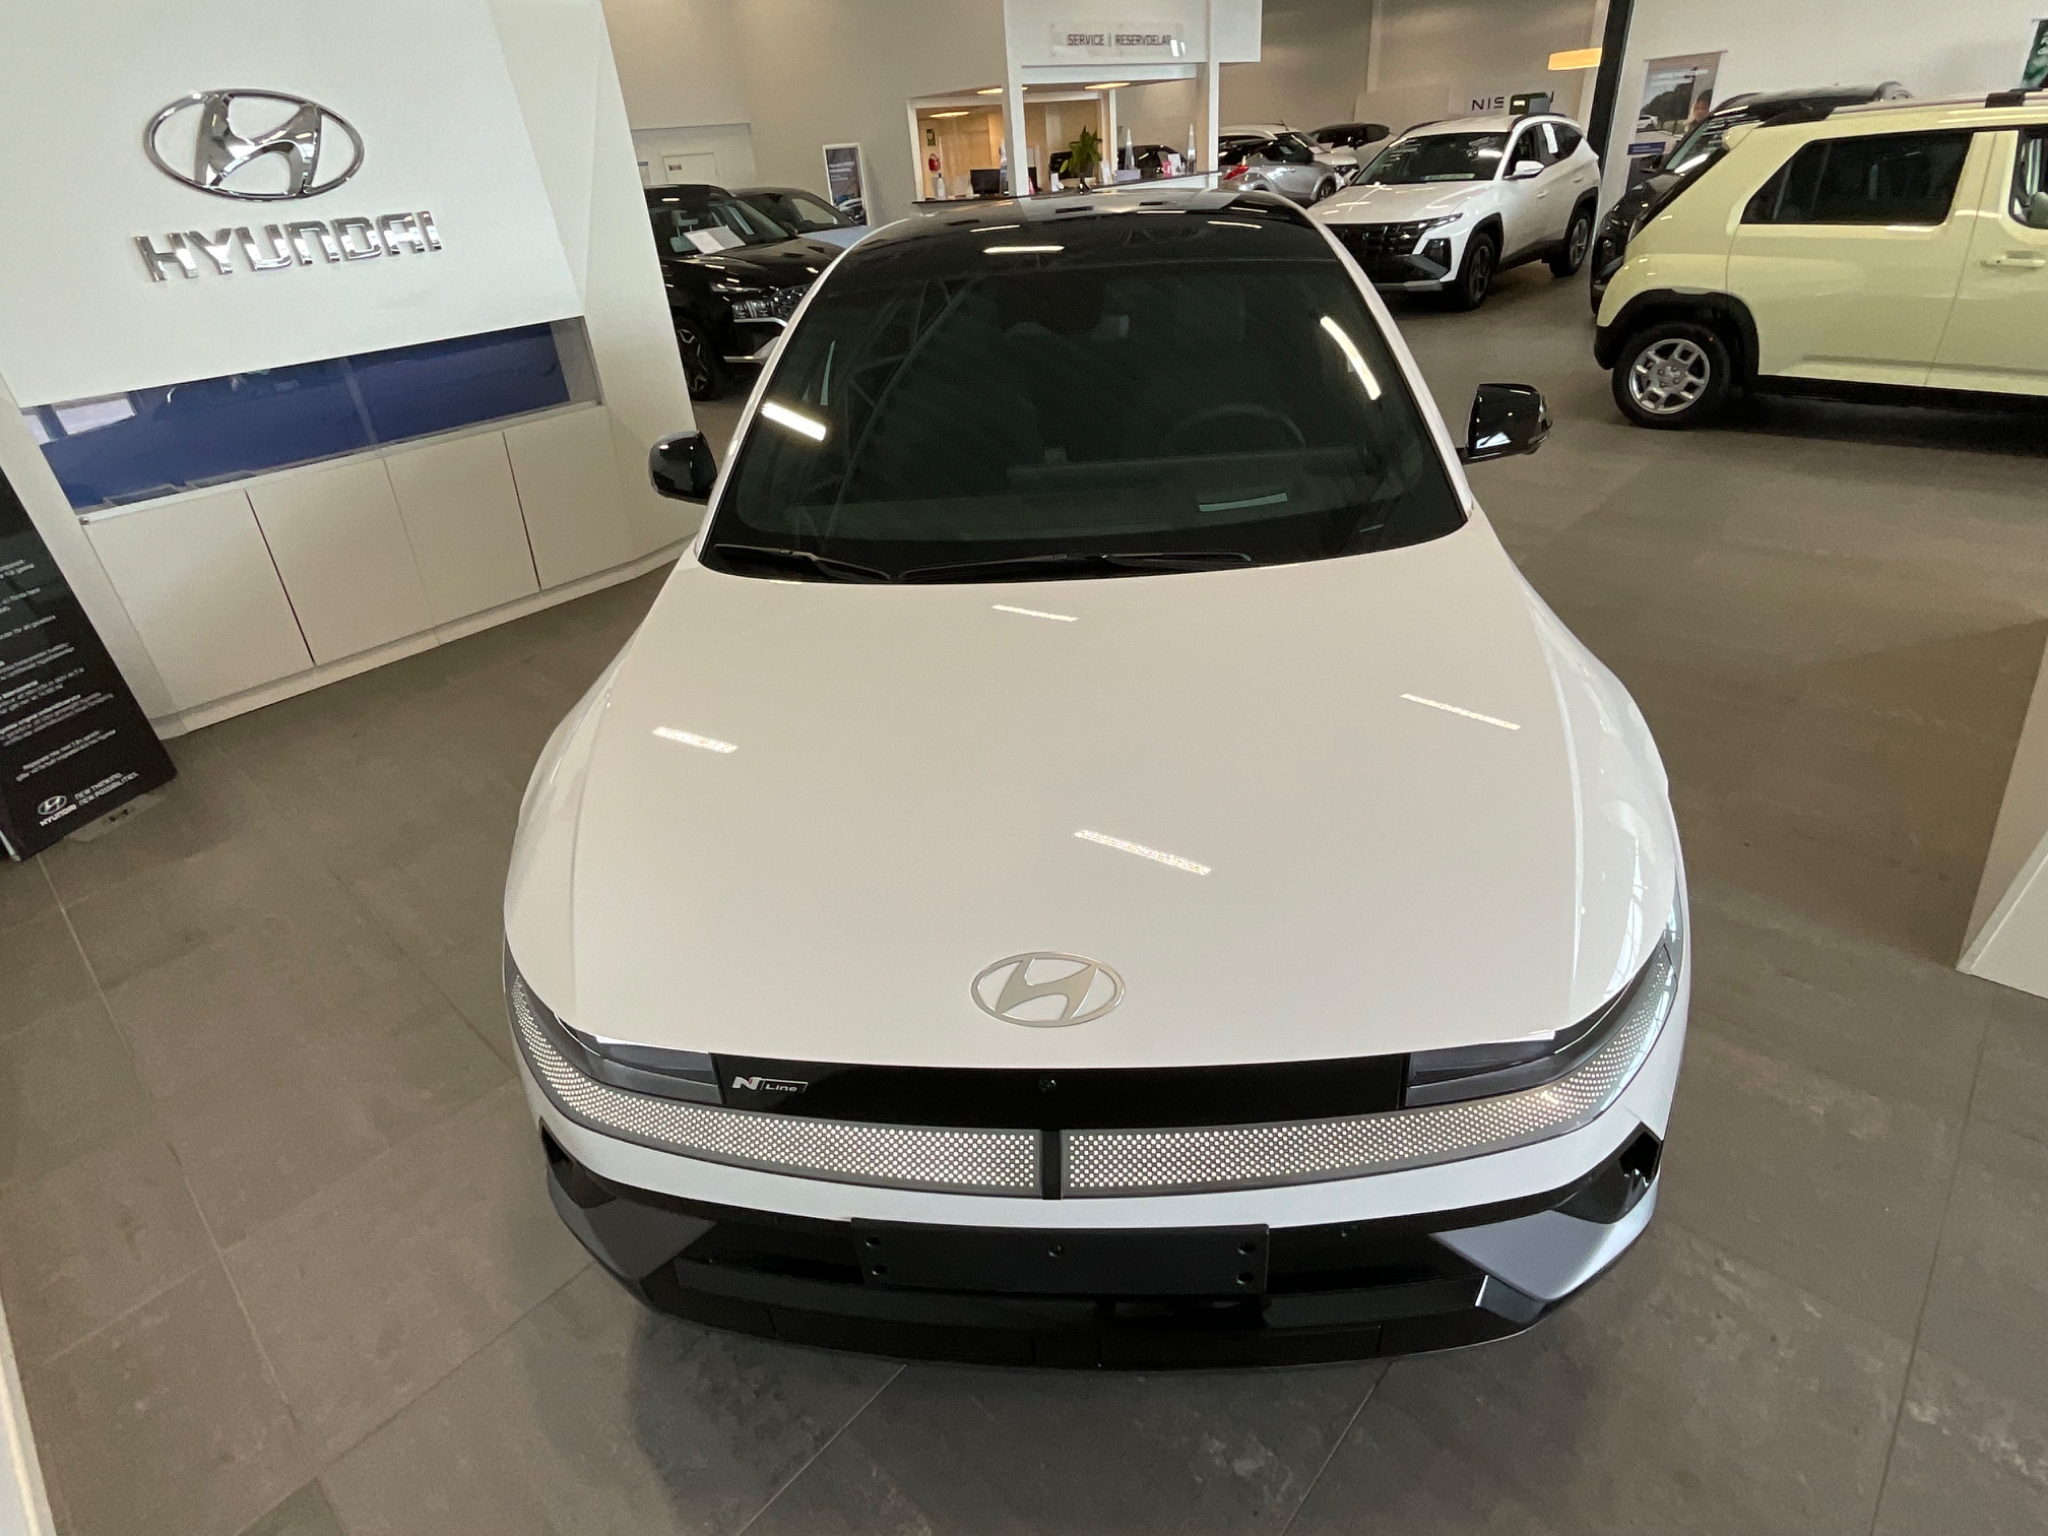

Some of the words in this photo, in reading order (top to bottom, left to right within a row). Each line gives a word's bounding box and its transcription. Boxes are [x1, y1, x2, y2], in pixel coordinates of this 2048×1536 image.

[1067, 34, 1105, 46] SERVICE
[134, 210, 443, 282] HYUNDAI
[39, 803, 77, 827] HYUNDAI
[731, 1076, 762, 1091] N
[765, 1083, 798, 1092] Line
